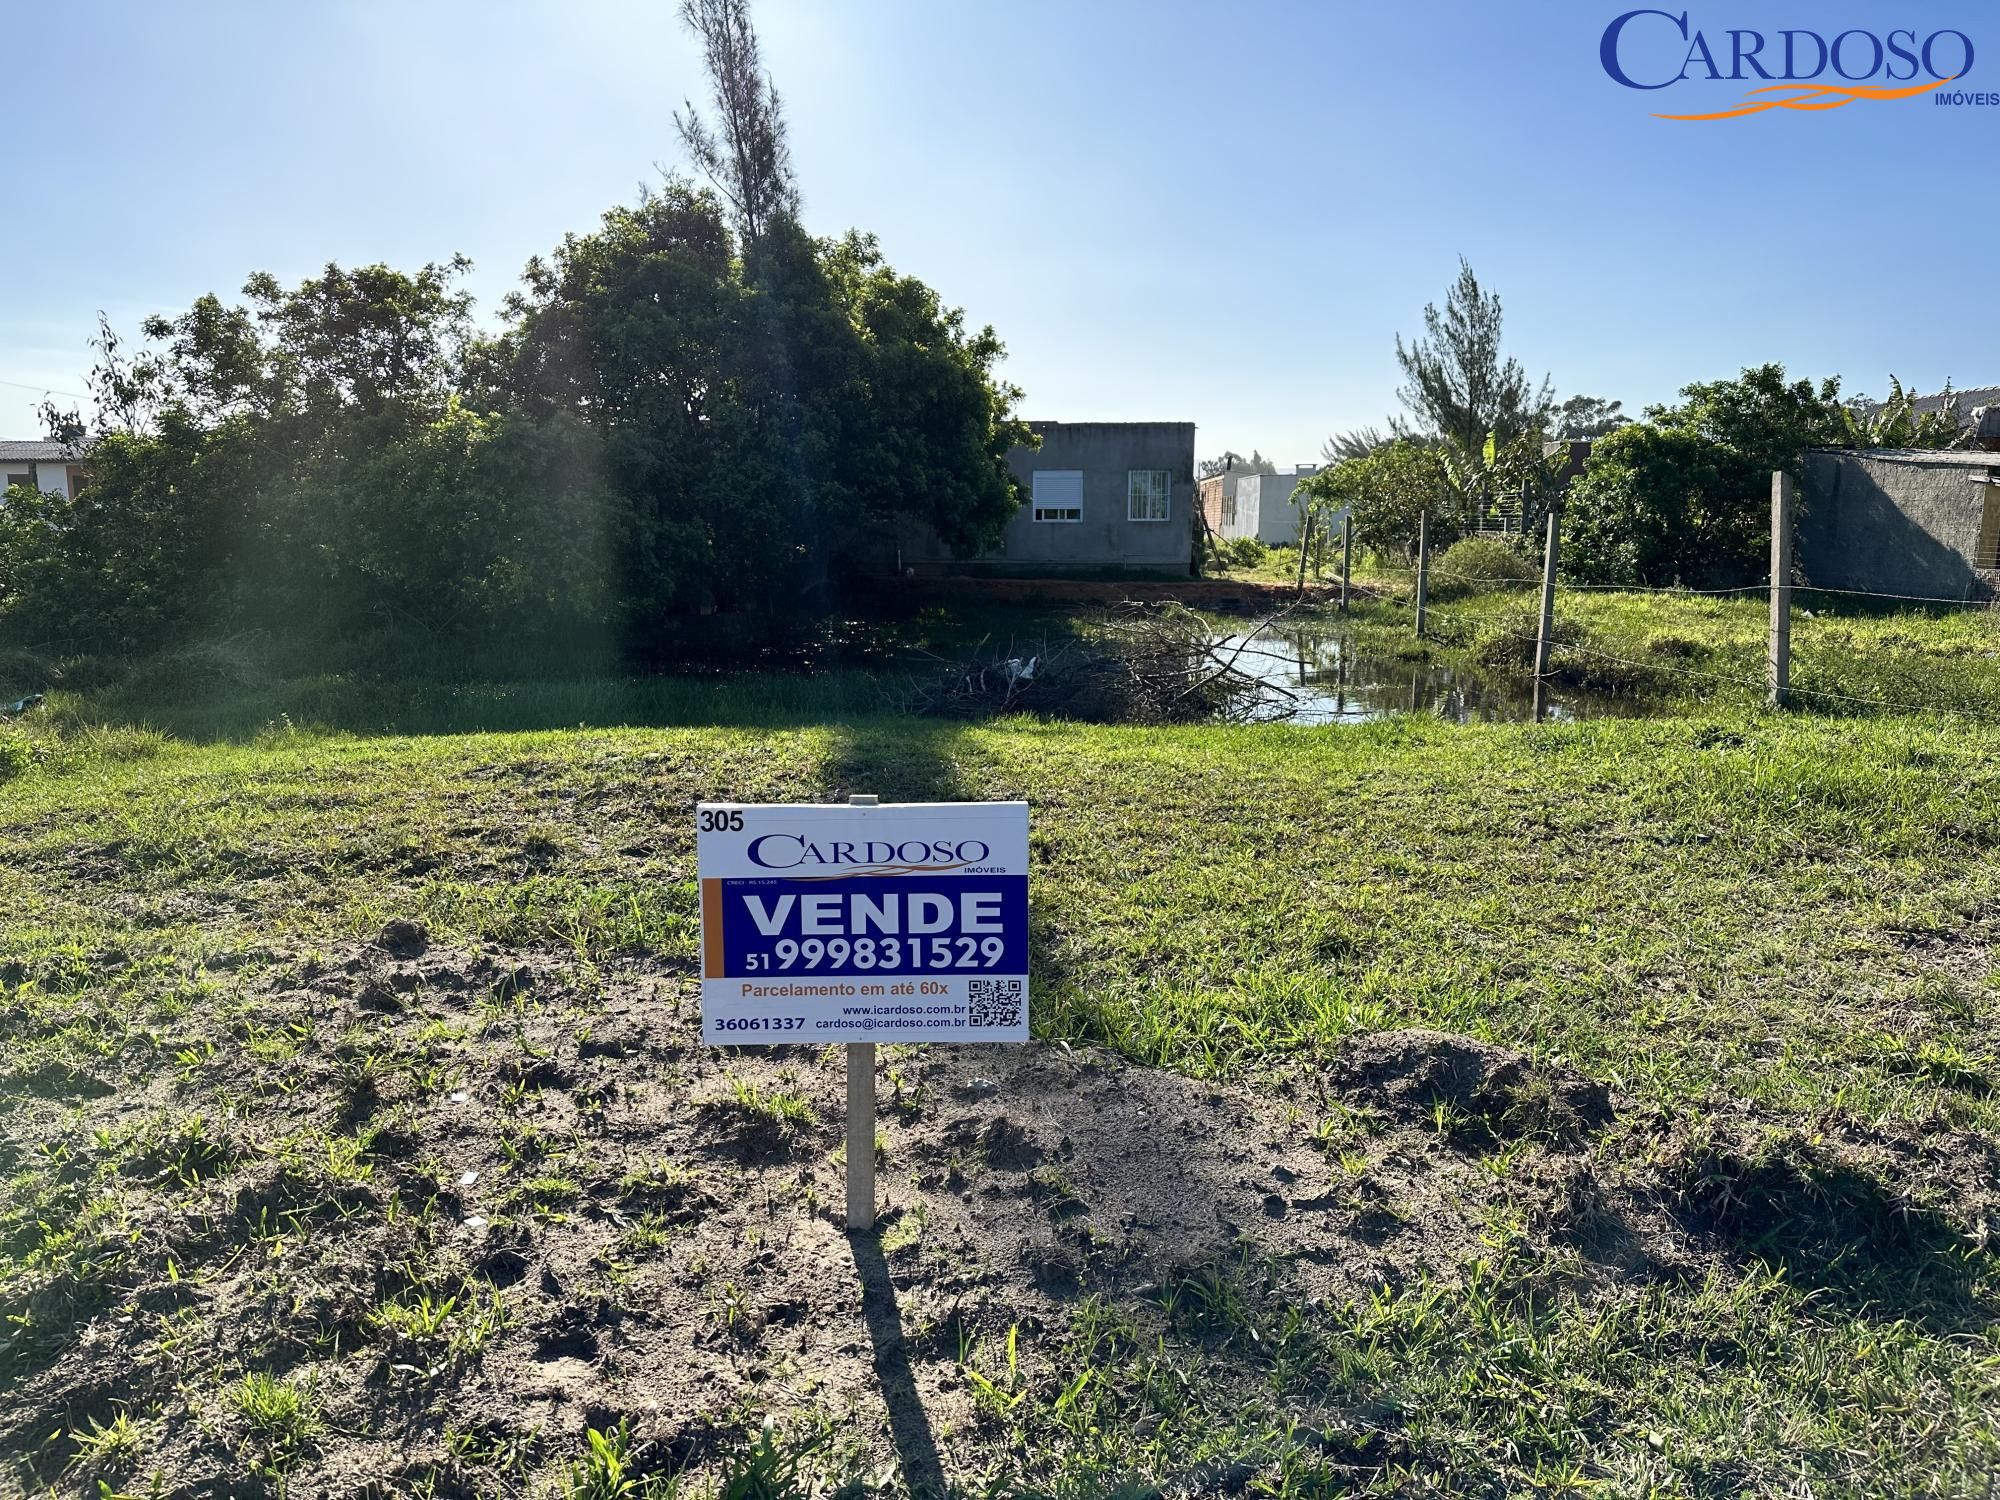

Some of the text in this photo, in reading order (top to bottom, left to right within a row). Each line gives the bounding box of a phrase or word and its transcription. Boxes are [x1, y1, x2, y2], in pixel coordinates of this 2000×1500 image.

[700, 810, 743, 832] 305
[747, 833, 989, 869] CARDOSO
[964, 865, 1006, 874] IMÓVEIS
[742, 892, 1003, 936] VENDE
[745, 936, 1004, 970] 51 999831529
[741, 981, 949, 997] Parcelamento em até 60x
[842, 1003, 967, 1015] www.icardoso.com.br
[714, 1017, 967, 1031] 36061337 cardoso@icardoso.com.br
